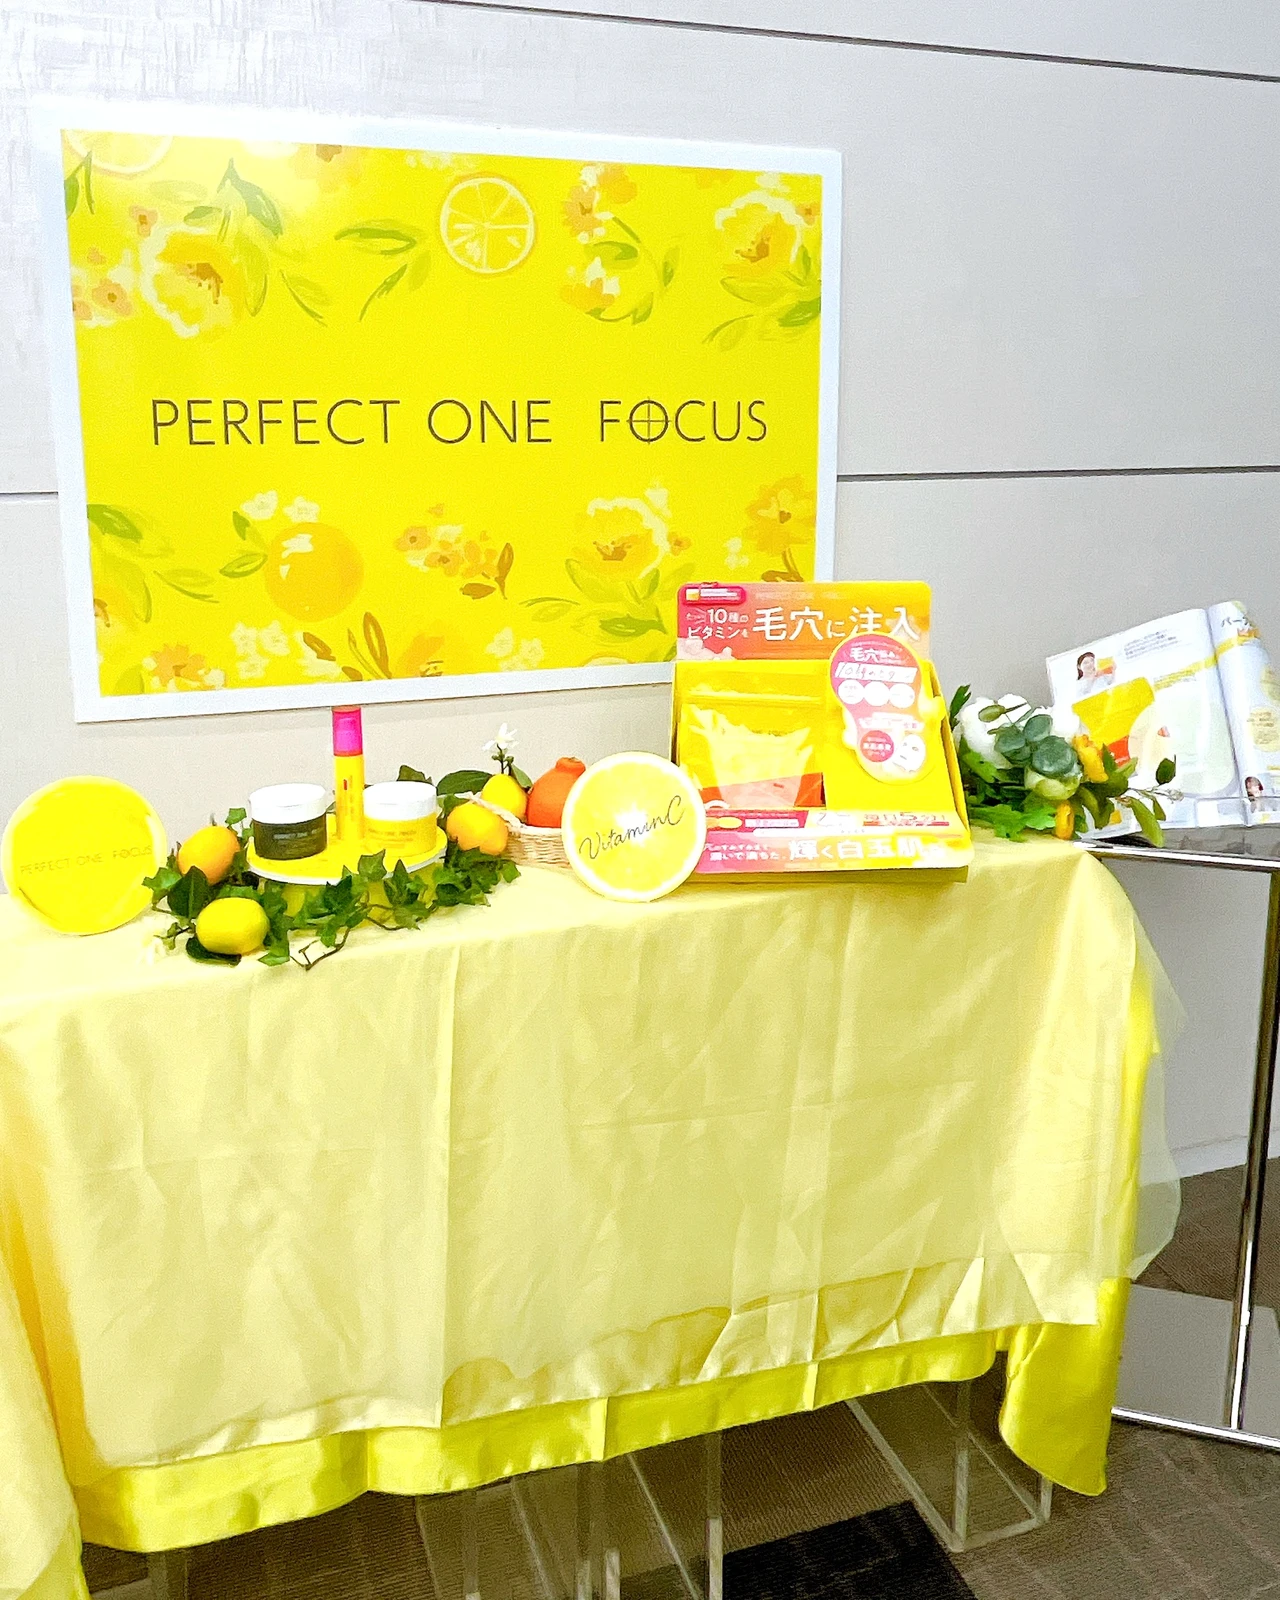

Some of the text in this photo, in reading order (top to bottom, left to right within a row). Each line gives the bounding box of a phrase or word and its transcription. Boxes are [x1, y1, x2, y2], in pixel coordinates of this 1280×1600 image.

[152, 396, 767, 445] PERFECT ONE FOCUS
[20, 845, 152, 875] PERFECT ONE FOCUS
